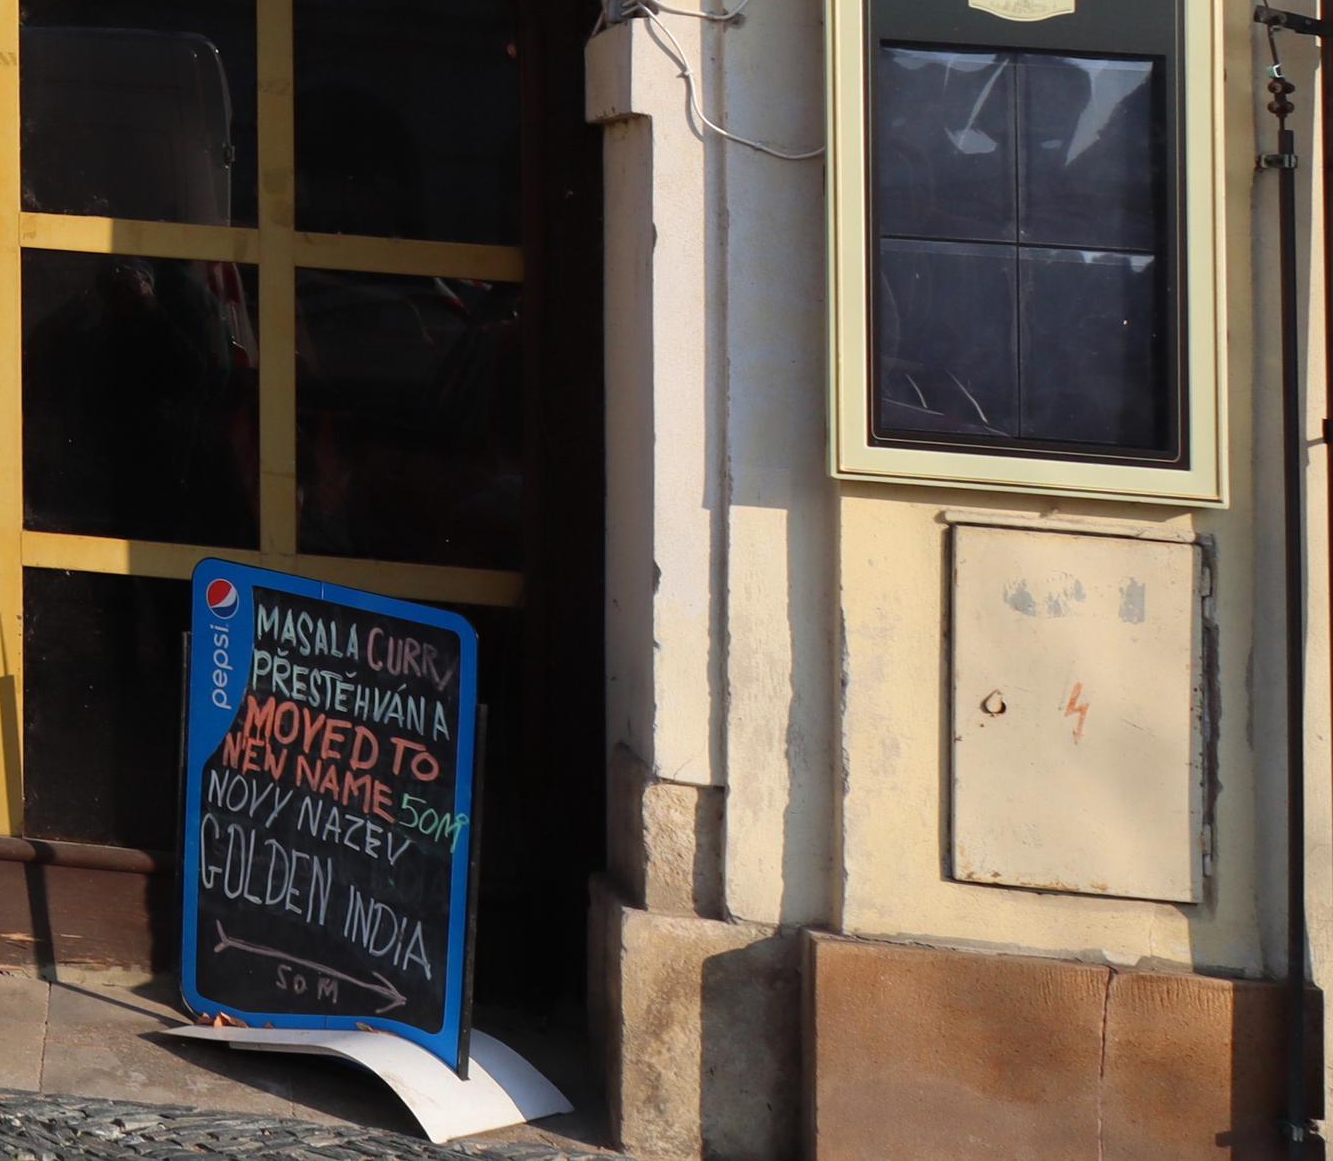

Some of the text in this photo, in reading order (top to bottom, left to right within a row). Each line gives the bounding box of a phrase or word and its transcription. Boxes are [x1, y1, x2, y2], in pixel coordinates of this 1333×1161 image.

[210, 624, 234, 710] pepsi
[257, 604, 359, 661] MASALA
[296, 755, 396, 824] NAME
[390, 737, 440, 782] TO
[343, 884, 431, 980] INDIA
